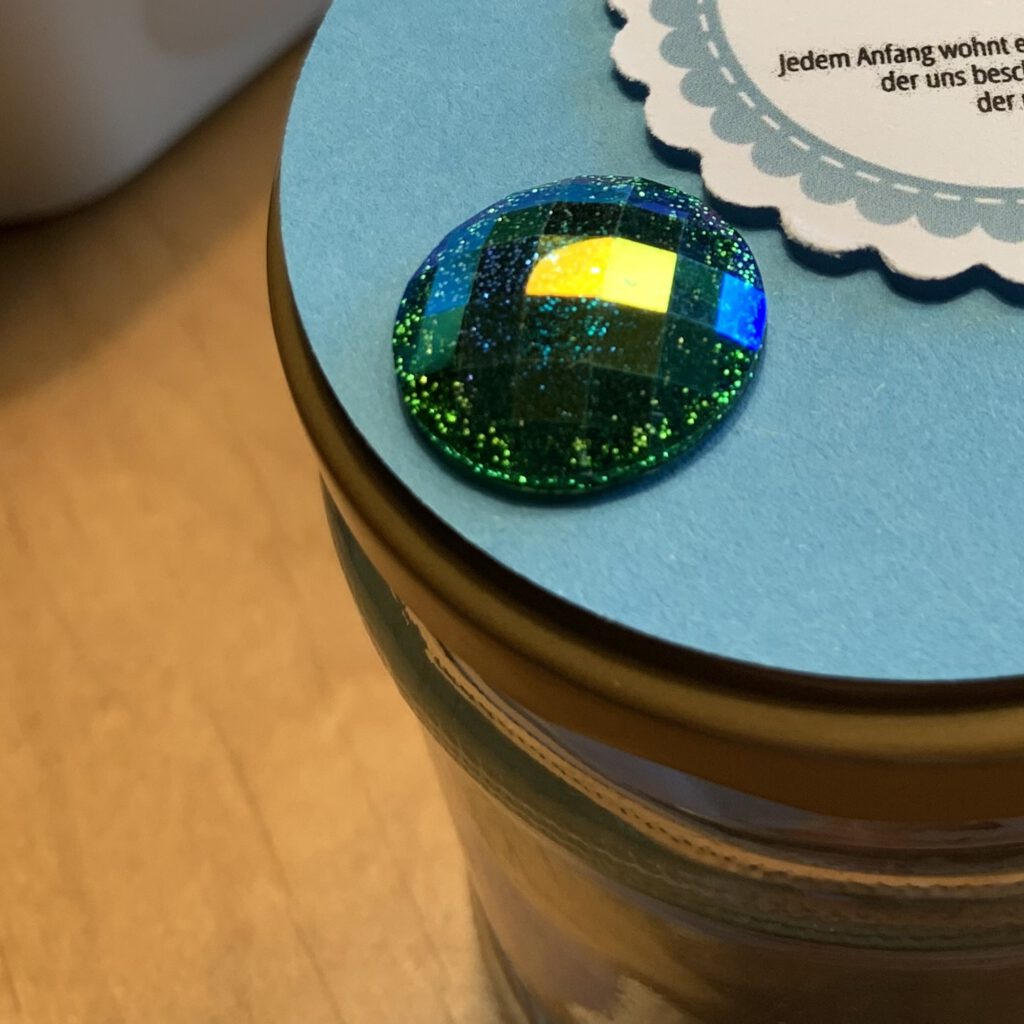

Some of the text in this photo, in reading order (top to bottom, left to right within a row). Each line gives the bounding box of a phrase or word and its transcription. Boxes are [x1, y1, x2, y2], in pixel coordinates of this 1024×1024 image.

[778, 50, 851, 78] Jedem
[857, 43, 936, 67] Anfang
[938, 36, 1010, 60] wohnt
[881, 71, 919, 92] der
[926, 70, 967, 88] uns
[977, 91, 1015, 113] der
